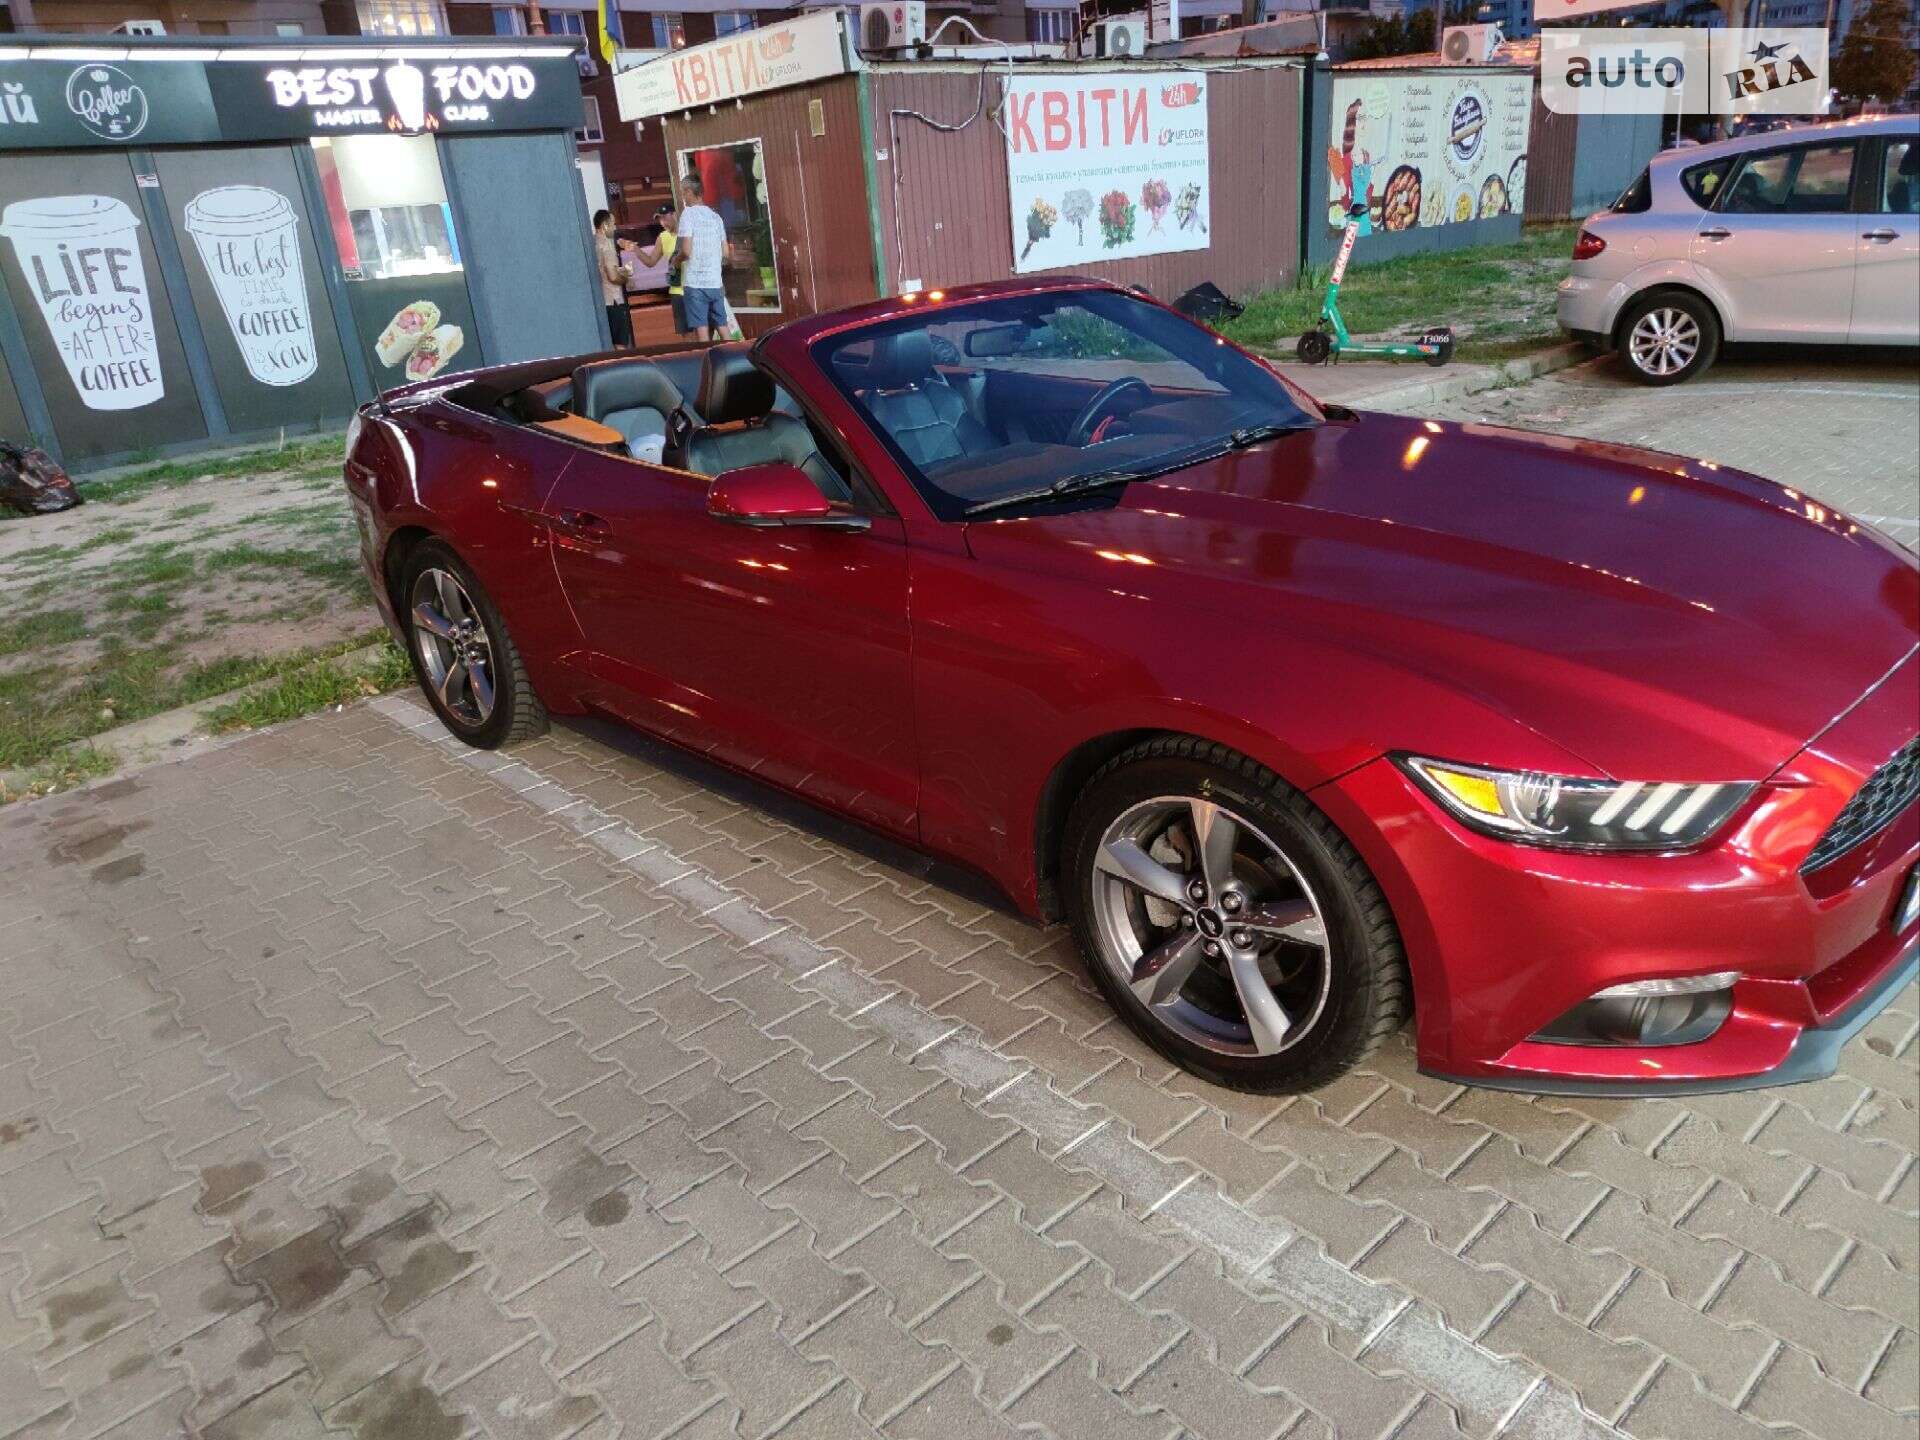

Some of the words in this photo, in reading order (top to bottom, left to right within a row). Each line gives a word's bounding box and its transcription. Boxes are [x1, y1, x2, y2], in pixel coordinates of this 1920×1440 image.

[266, 67, 379, 107] BEST
[431, 65, 536, 104] FOOD
[672, 40, 761, 104] КВІТИ
[79, 84, 132, 126] Coffee
[315, 109, 382, 127] MASTER
[443, 105, 490, 121] CLASS
[1010, 87, 1149, 153] КВІТИ
[213, 241, 255, 277] the
[254, 234, 291, 277] best
[55, 298, 143, 332] begins
[239, 306, 304, 337] COFFEE
[71, 324, 150, 360] AFTER
[80, 358, 157, 391] COFFEE
